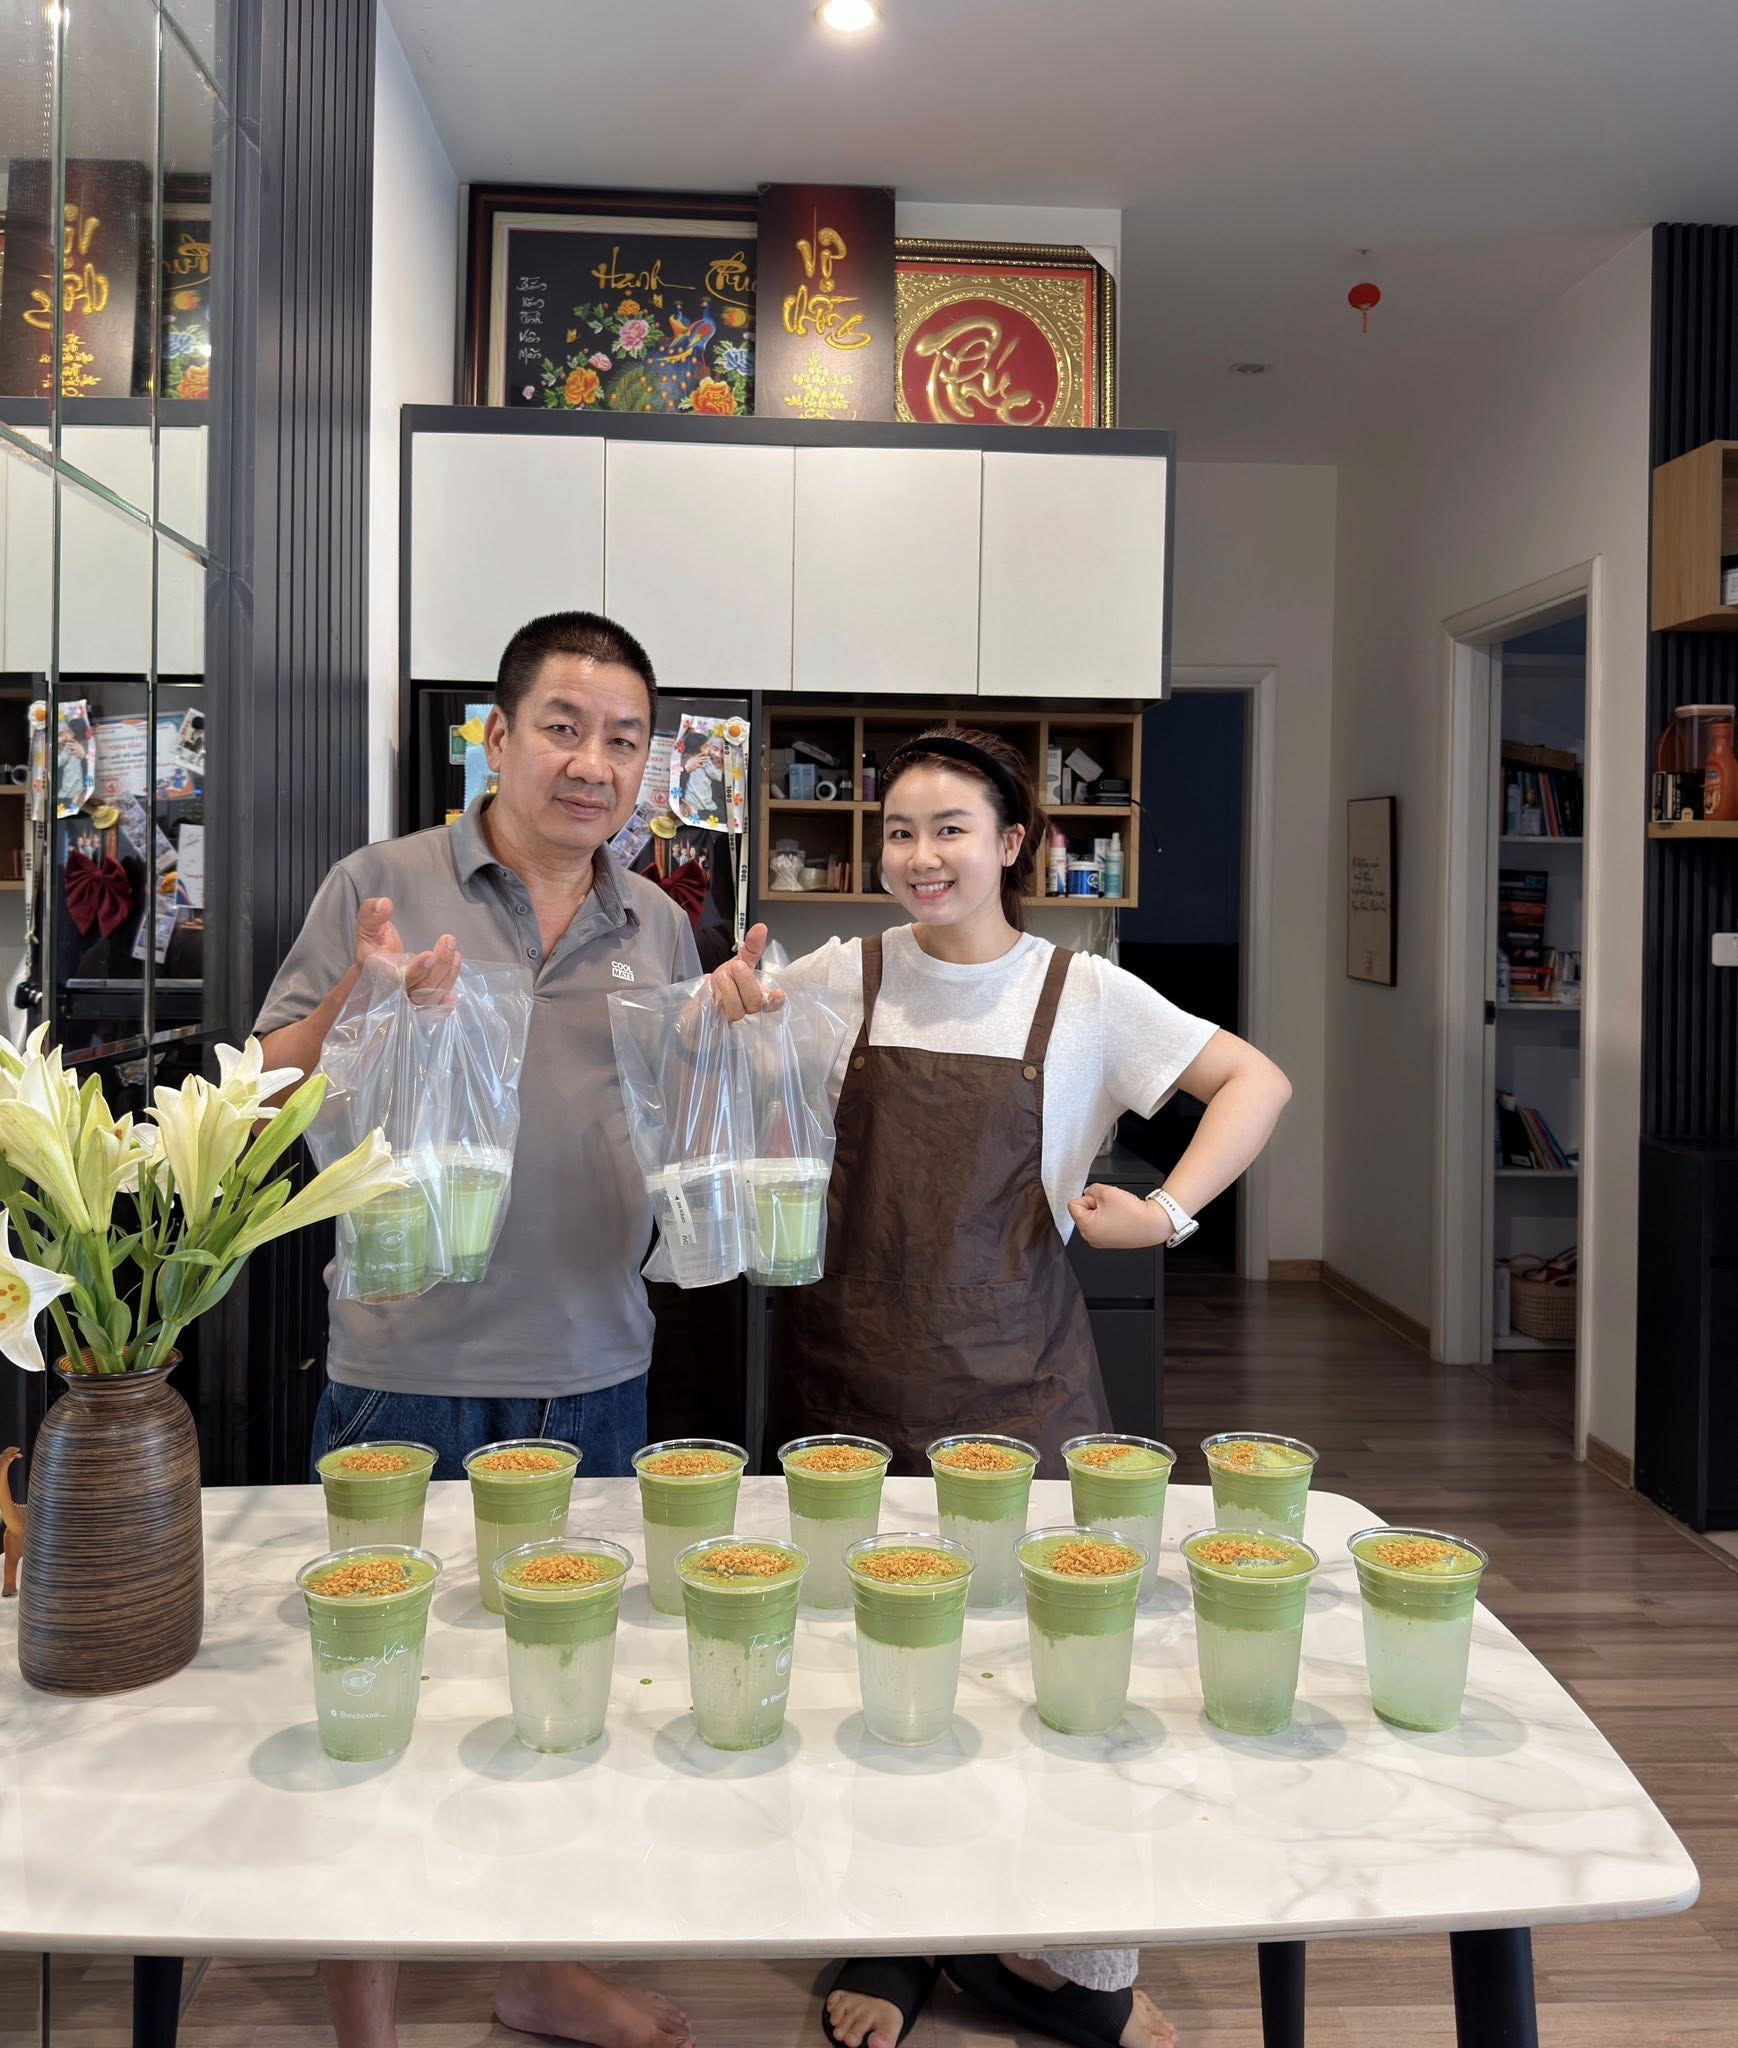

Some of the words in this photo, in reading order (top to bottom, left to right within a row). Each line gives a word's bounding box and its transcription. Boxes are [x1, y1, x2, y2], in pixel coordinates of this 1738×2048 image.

[591, 246, 696, 296] Hạnh
[611, 961, 633, 974] COOL
[613, 968, 634, 981] MATE
